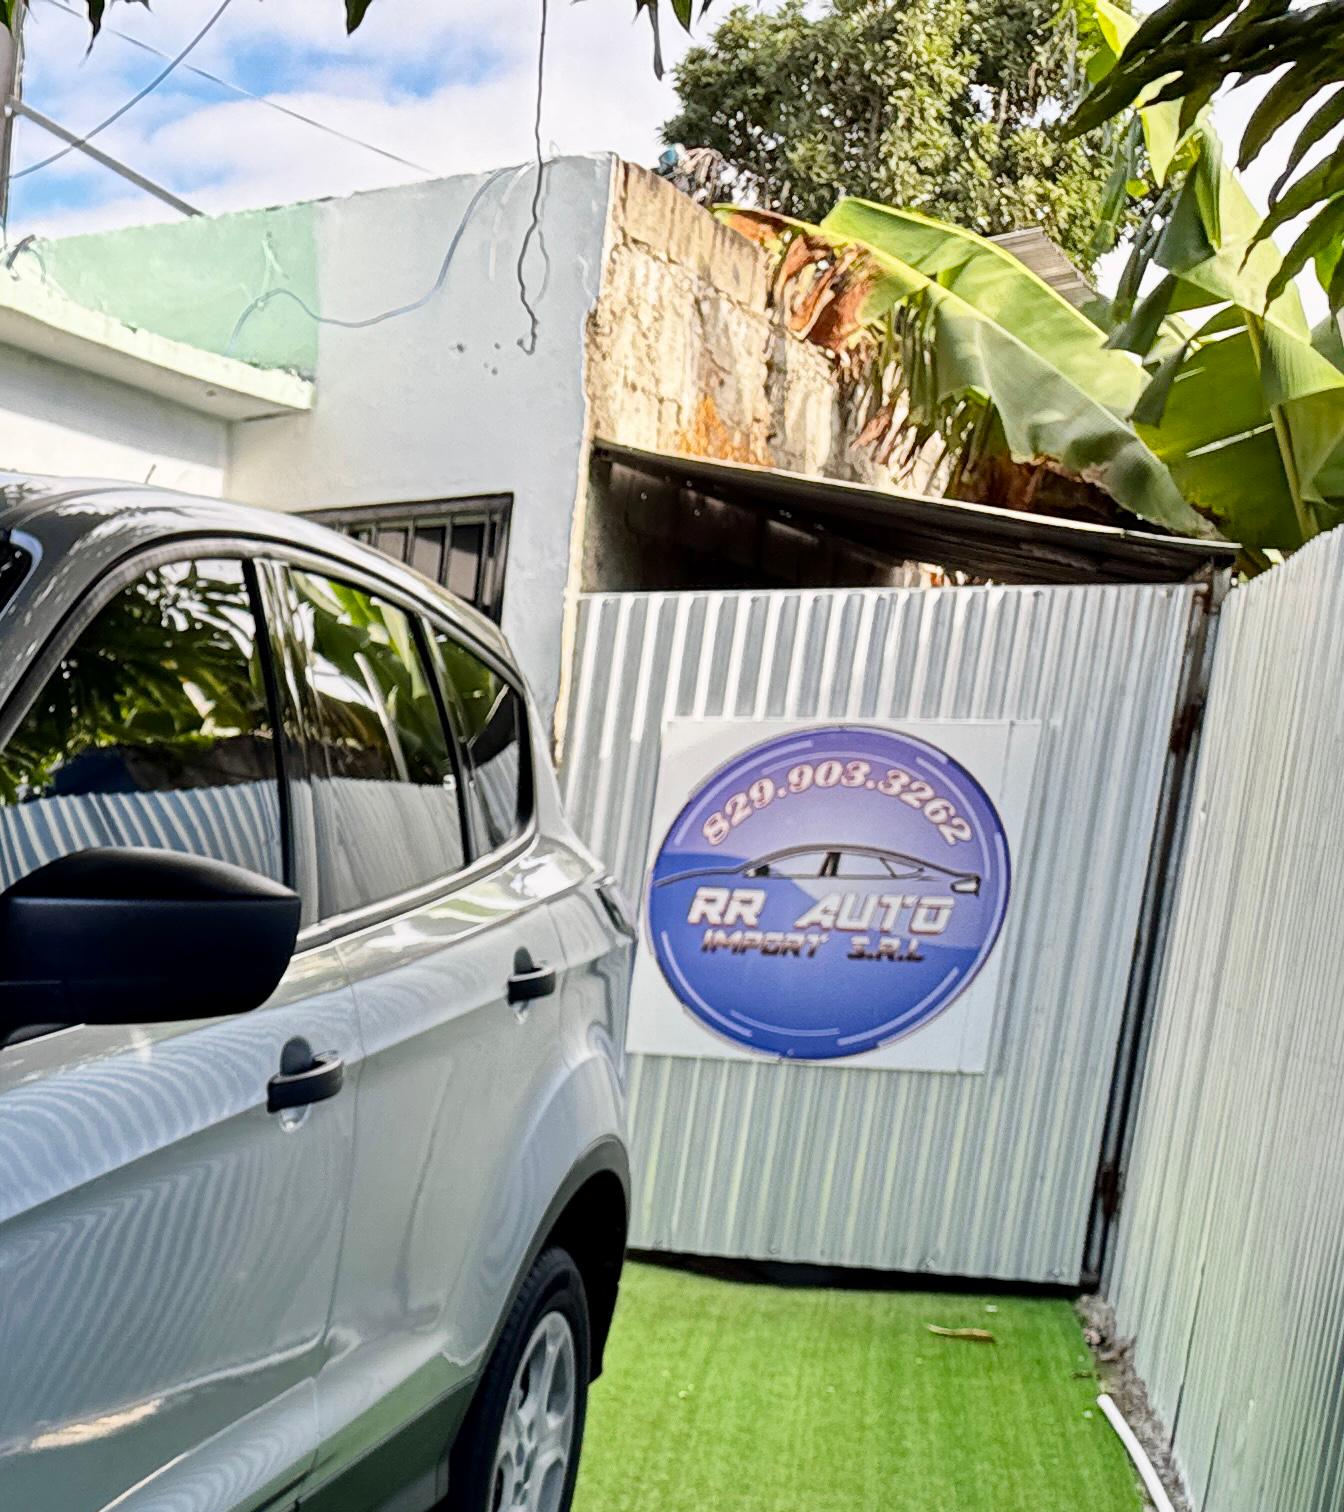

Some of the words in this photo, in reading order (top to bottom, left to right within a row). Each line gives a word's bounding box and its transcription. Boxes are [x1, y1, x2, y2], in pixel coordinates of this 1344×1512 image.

[701, 760, 973, 846] 829.903.3262
[687, 885, 766, 928] RR
[793, 892, 956, 935] AUTO
[700, 928, 830, 961] IMPORT
